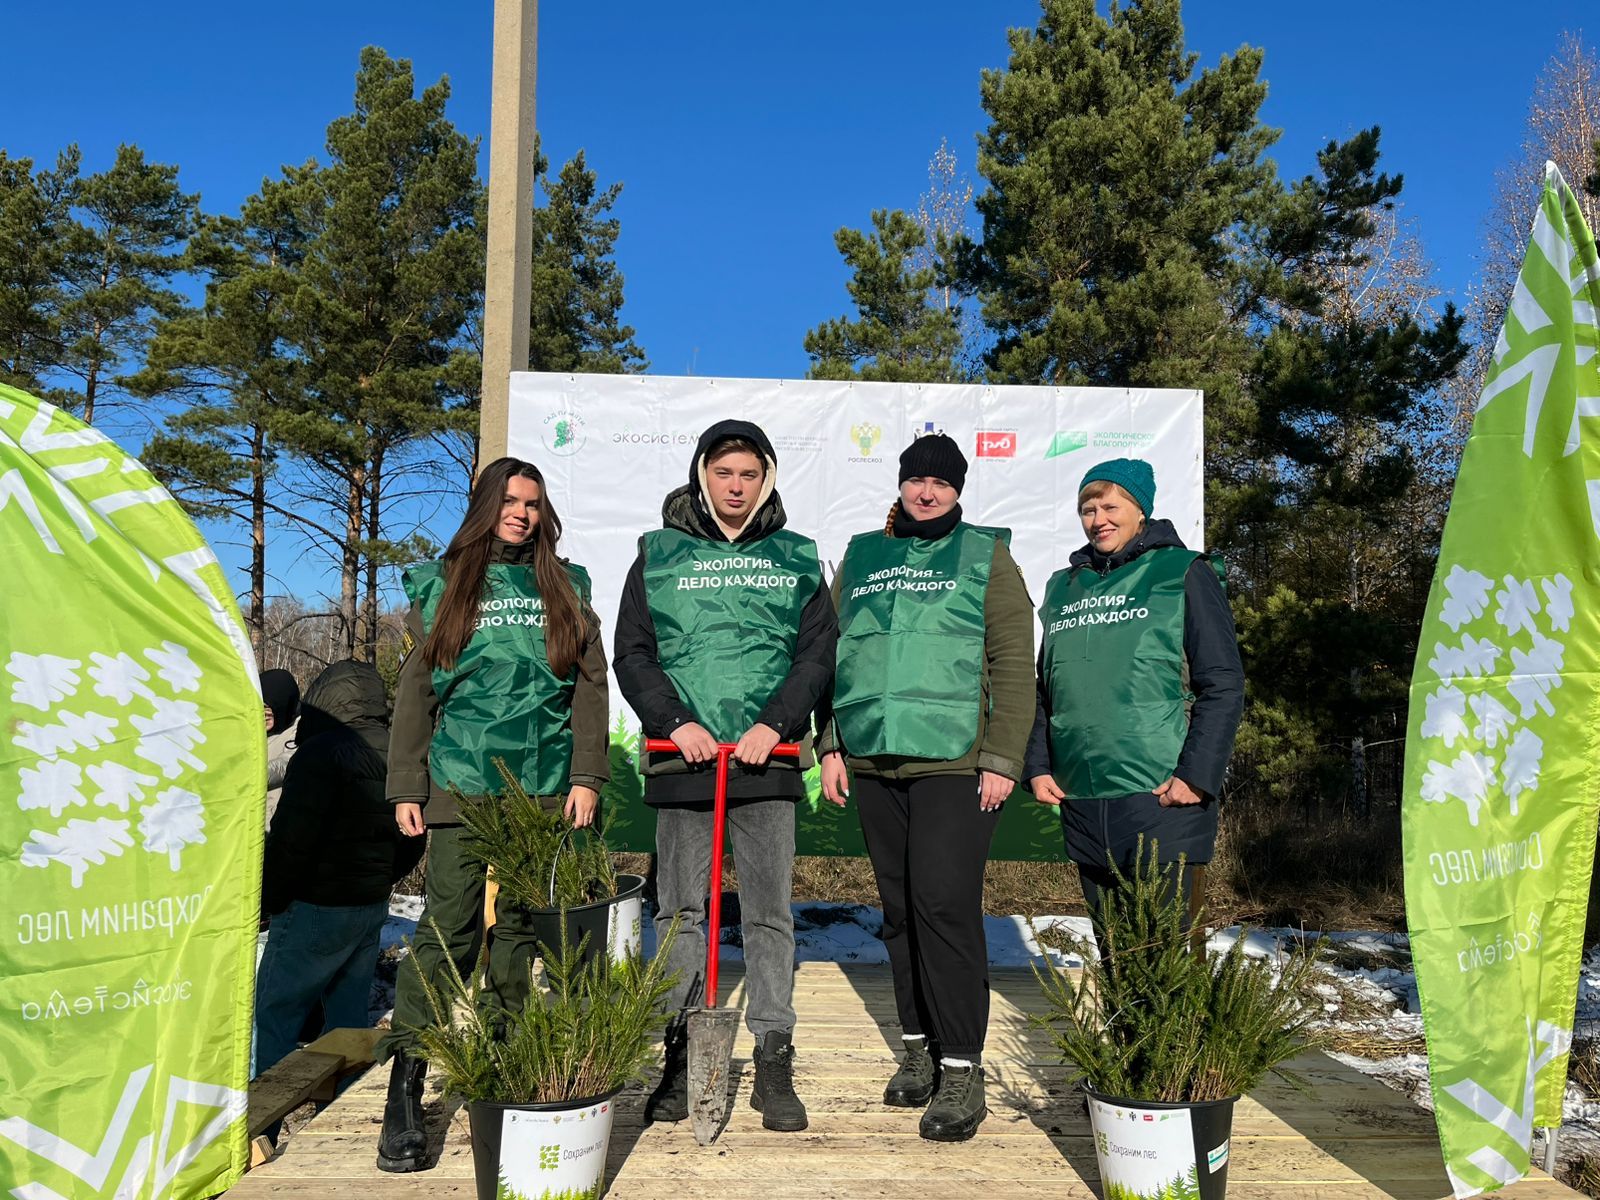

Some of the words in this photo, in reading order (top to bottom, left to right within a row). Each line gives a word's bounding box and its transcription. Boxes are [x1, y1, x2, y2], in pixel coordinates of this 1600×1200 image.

[612, 431, 700, 445] экосистем
[692, 557, 772, 571] ЭКОЛОГИЯ
[865, 565, 933, 583] ЭКОЛОГИЯ
[677, 576, 722, 591] ДЕЛО
[724, 575, 798, 589] КАЖДОГО
[851, 582, 884, 600] ДЕЛО
[886, 579, 957, 592] КАЖДОГО
[478, 597, 546, 613] КОЛОГИ
[1060, 595, 1125, 616] ЭКОЛОГИЯ
[474, 616, 504, 630] ЛО
[506, 614, 548, 628] КАЖД
[1049, 618, 1077, 636] ДЕЛО
[1078, 607, 1149, 626] КАЖДОГО
[1143, 1150, 1158, 1160] лес
